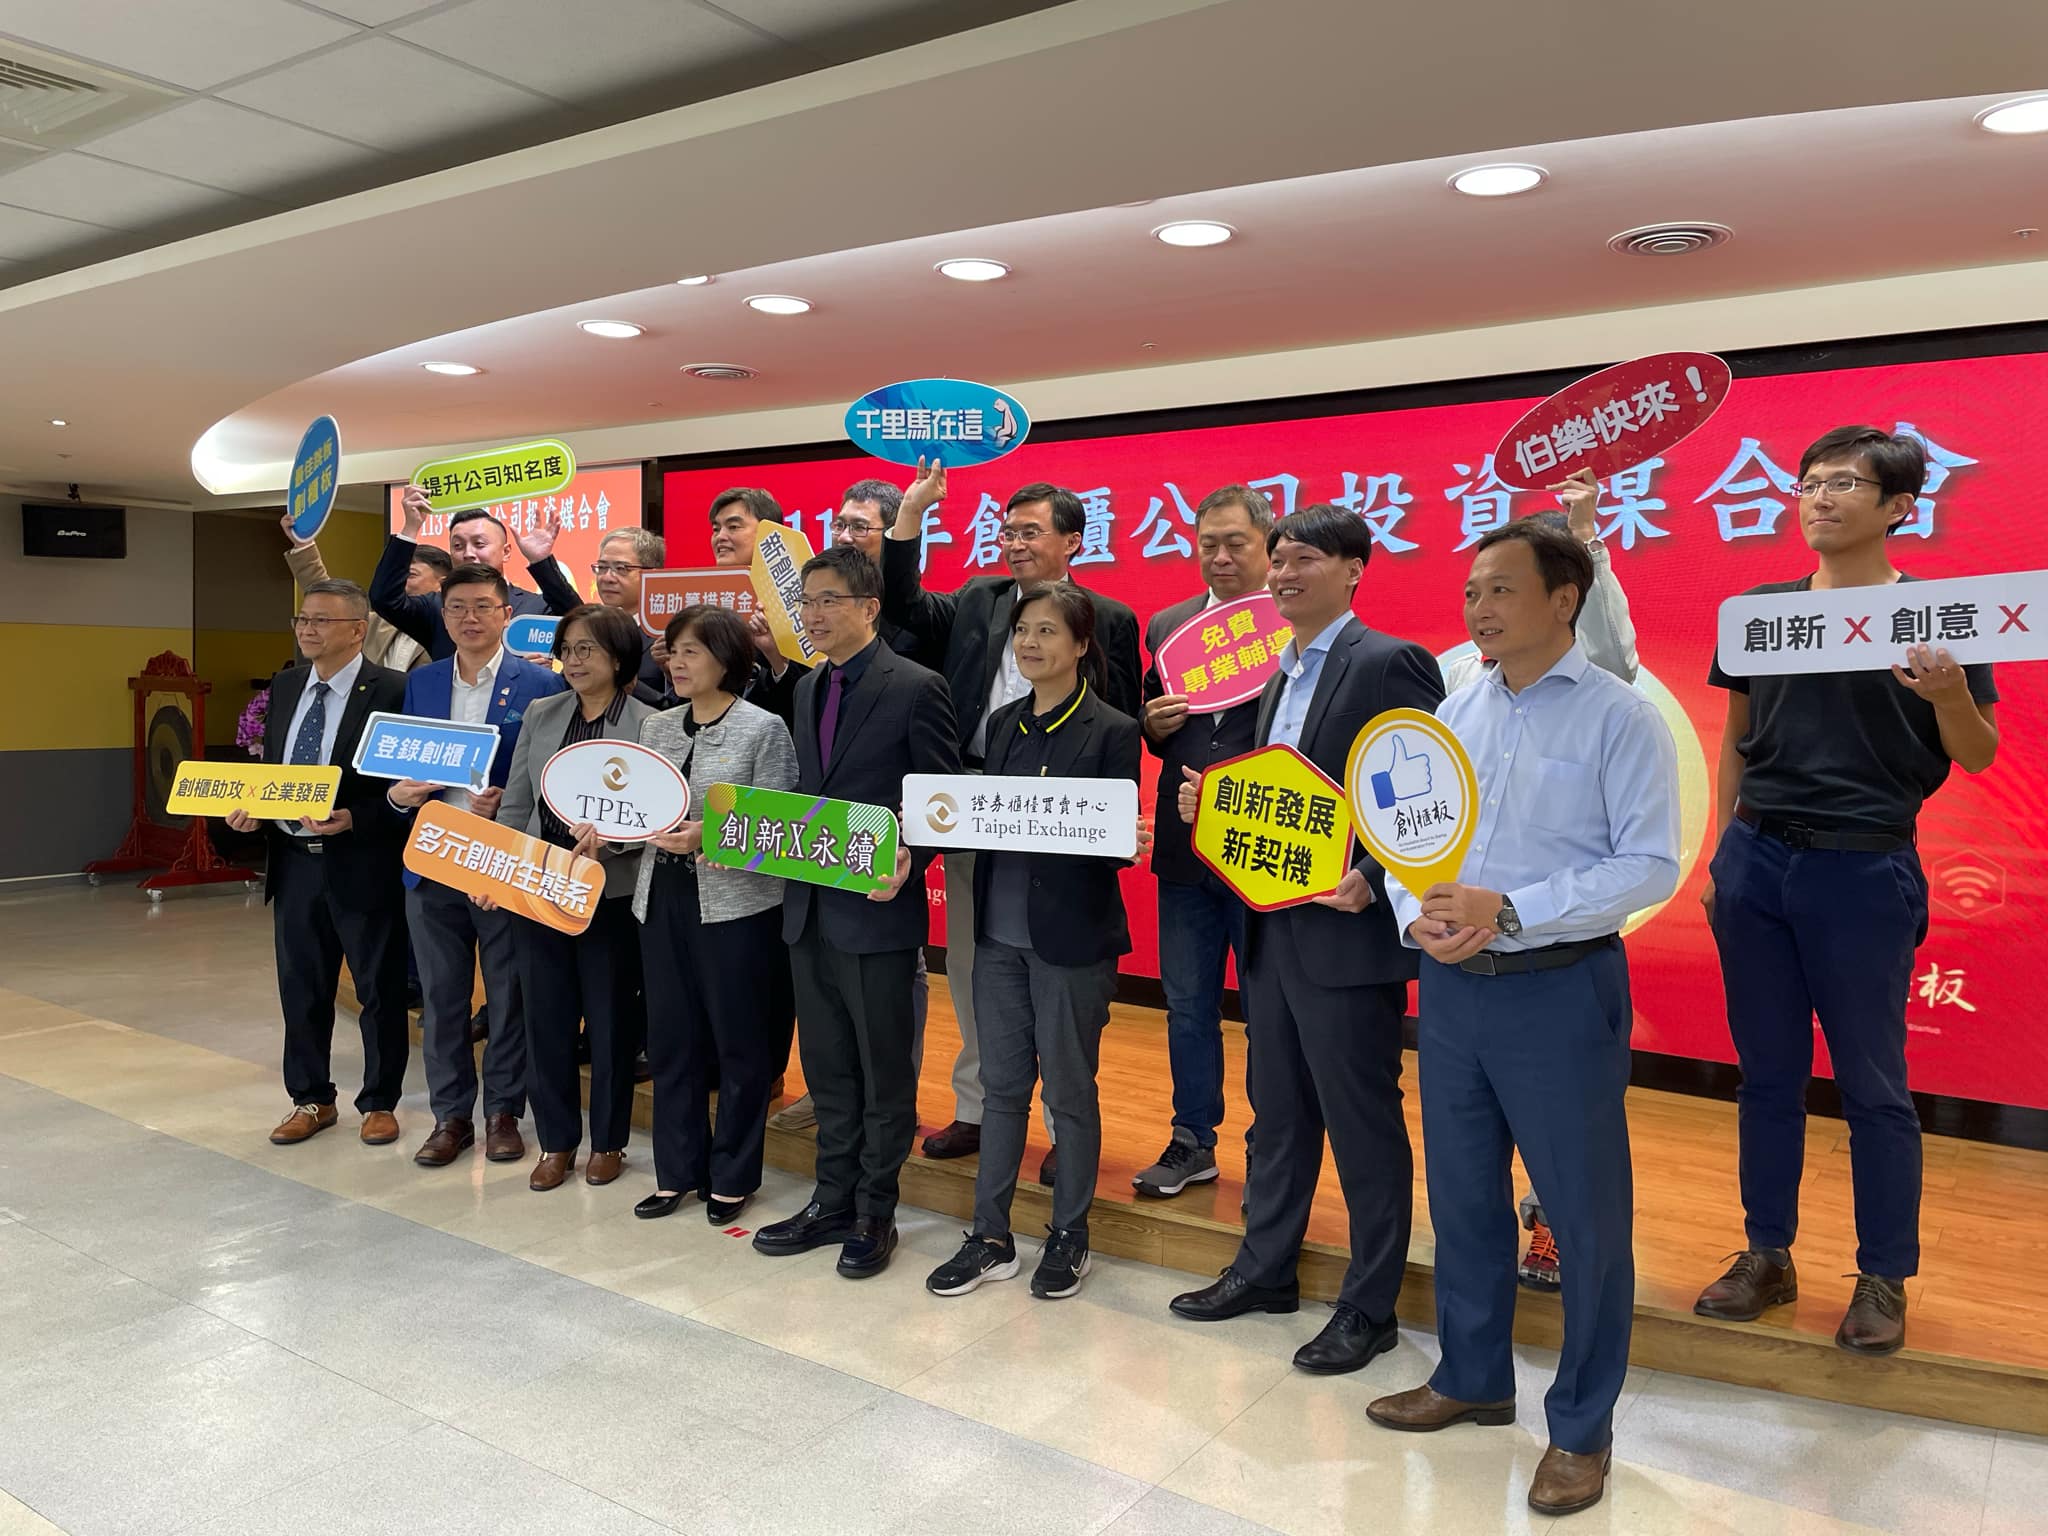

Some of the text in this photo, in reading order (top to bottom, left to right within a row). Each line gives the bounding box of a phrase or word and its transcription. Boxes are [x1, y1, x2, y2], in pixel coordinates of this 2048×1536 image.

[856, 408, 983, 440] 千里馬在這
[422, 456, 563, 499] 提升公司知名度
[649, 591, 753, 615] 協助籌措資金
[528, 627, 553, 644] Mee
[1200, 609, 1258, 654] 免費
[1744, 614, 1826, 652] 創新
[1891, 602, 1979, 644] 創意
[1181, 626, 1294, 693] 專業輔導
[176, 778, 245, 799] 創櫃助攻
[260, 781, 330, 802] 企業發展
[576, 794, 648, 828] TPEx
[1214, 775, 1337, 839] 創新發展
[972, 817, 1107, 843] Taipei Exchange
[1393, 800, 1455, 841] 創櫃板
[414, 822, 593, 914] 多元創新生態系
[1221, 827, 1313, 887] 新契機
